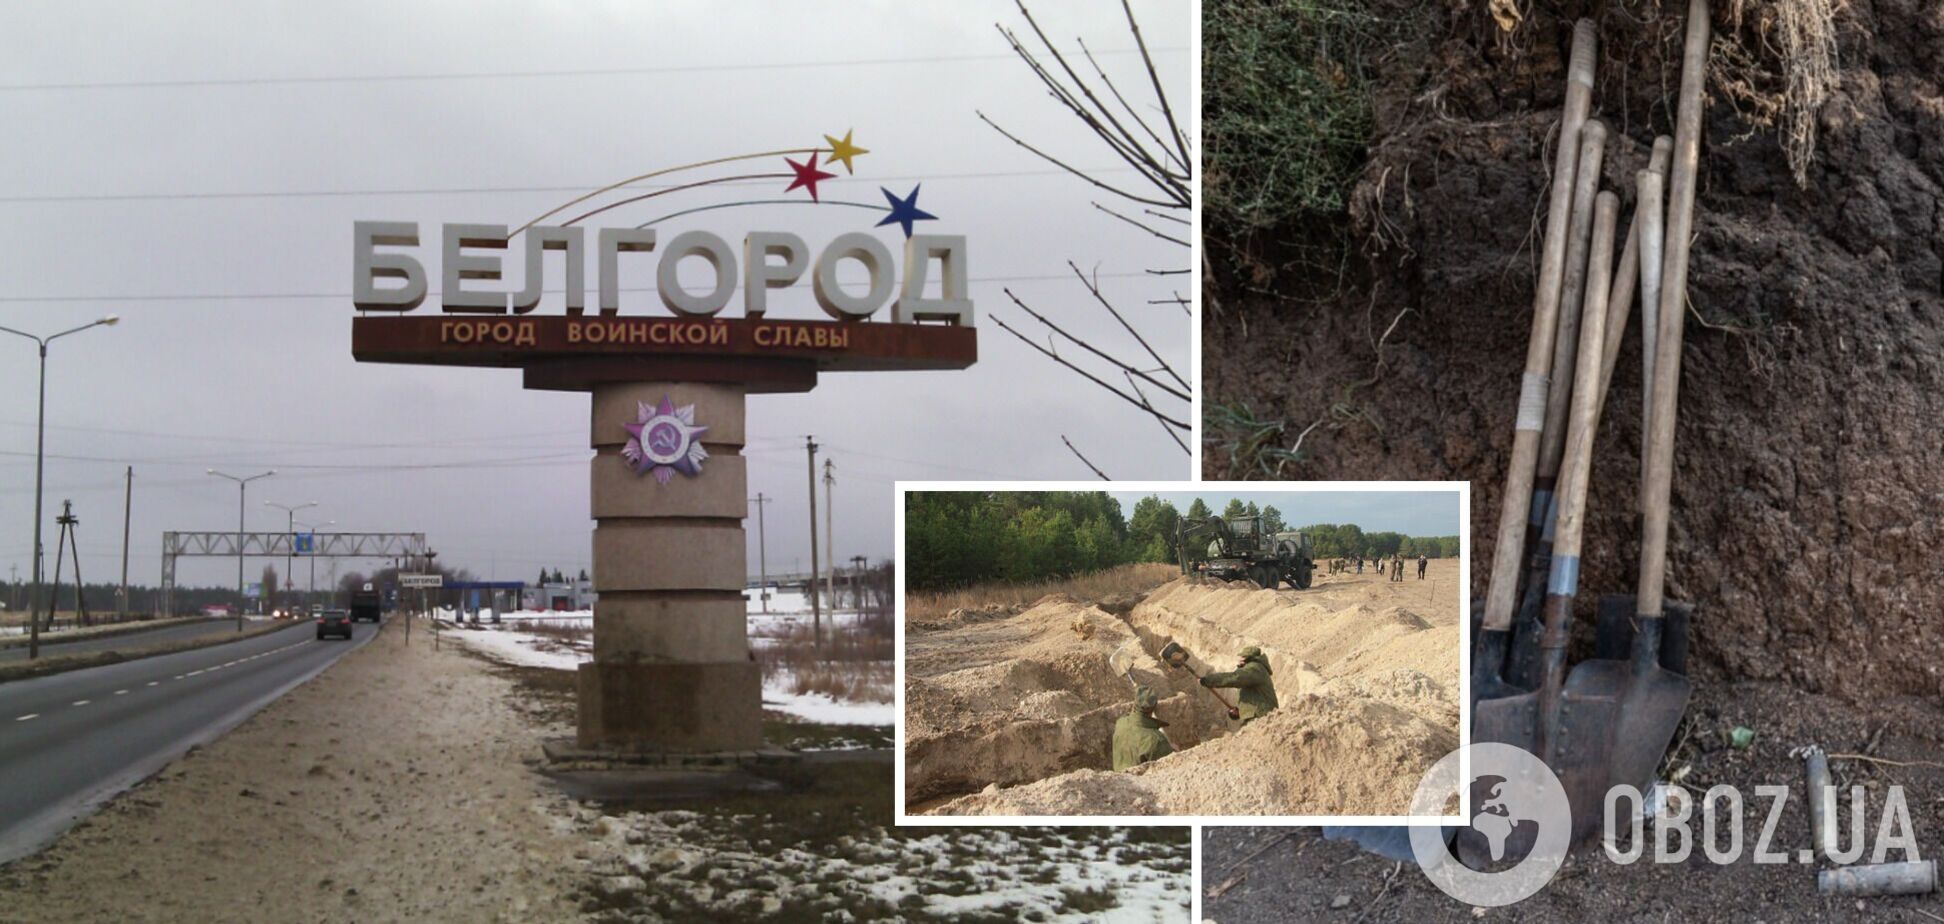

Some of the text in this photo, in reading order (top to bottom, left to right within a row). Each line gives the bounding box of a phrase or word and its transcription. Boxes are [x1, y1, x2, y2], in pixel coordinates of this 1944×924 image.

[353, 220, 975, 327] БЕЛГОРОД
[441, 319, 849, 347] ГОРОД ВОИНСКОЙ СЛАВЫ
